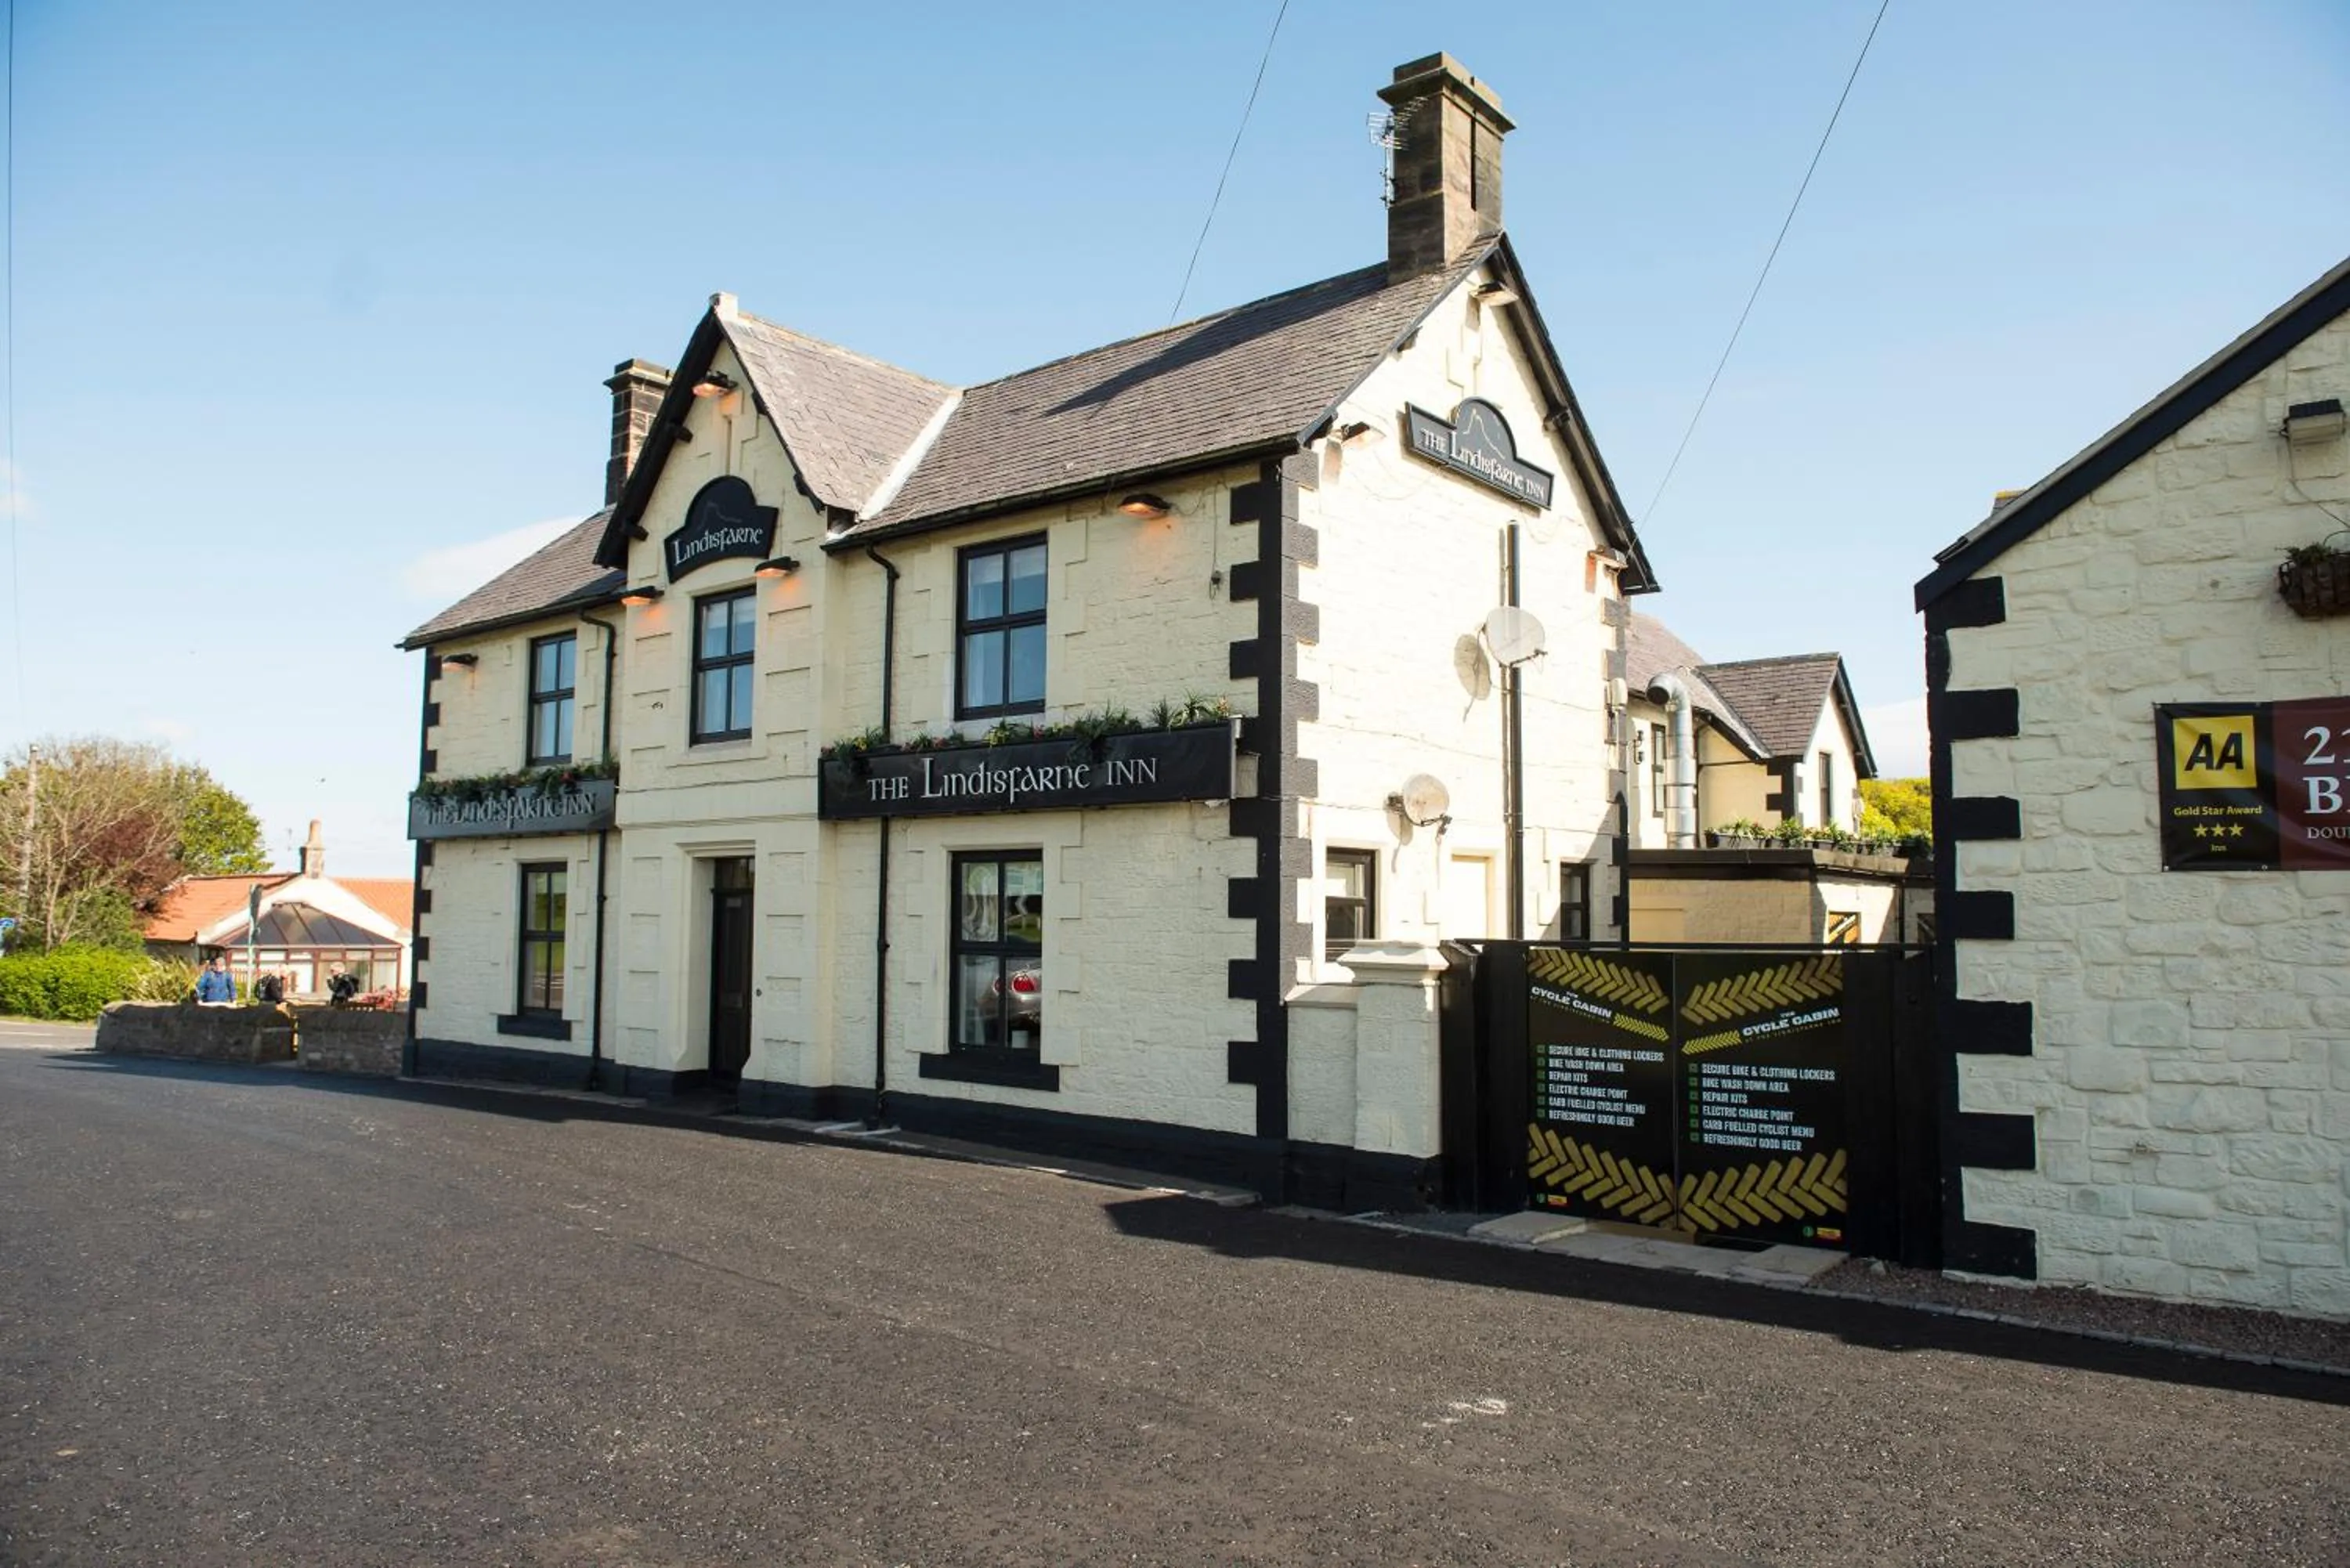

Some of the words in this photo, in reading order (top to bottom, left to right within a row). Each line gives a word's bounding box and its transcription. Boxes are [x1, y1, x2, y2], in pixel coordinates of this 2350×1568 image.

[1421, 428, 1448, 452] THE
[1451, 431, 1524, 490] Lindisfarne
[674, 528, 763, 565] Lindisfarne
[2184, 732, 2244, 771] AA
[867, 776, 909, 802] THE
[920, 757, 1090, 804] Lindisfarne
[1105, 757, 1158, 786] INN
[2302, 776, 2350, 815] B
[2174, 805, 2200, 816] Gold
[2202, 804, 2224, 815] Star
[2226, 805, 2263, 815] Award
[1531, 986, 1571, 1005] CYCLE
[1572, 999, 1612, 1018] CABIN
[1742, 1019, 1790, 1036] CYCLE
[1791, 1007, 1840, 1026] CABIN
[1701, 1064, 1730, 1075] SECURE
[1759, 1067, 1798, 1078] CLOTHING
[1799, 1069, 1835, 1081] LOCKERS
[1721, 1078, 1743, 1090] WASH
[1769, 1082, 1790, 1093] AREA
[1703, 1105, 1737, 1118] ELECTRIC
[1724, 1121, 1757, 1133] FUELLED
